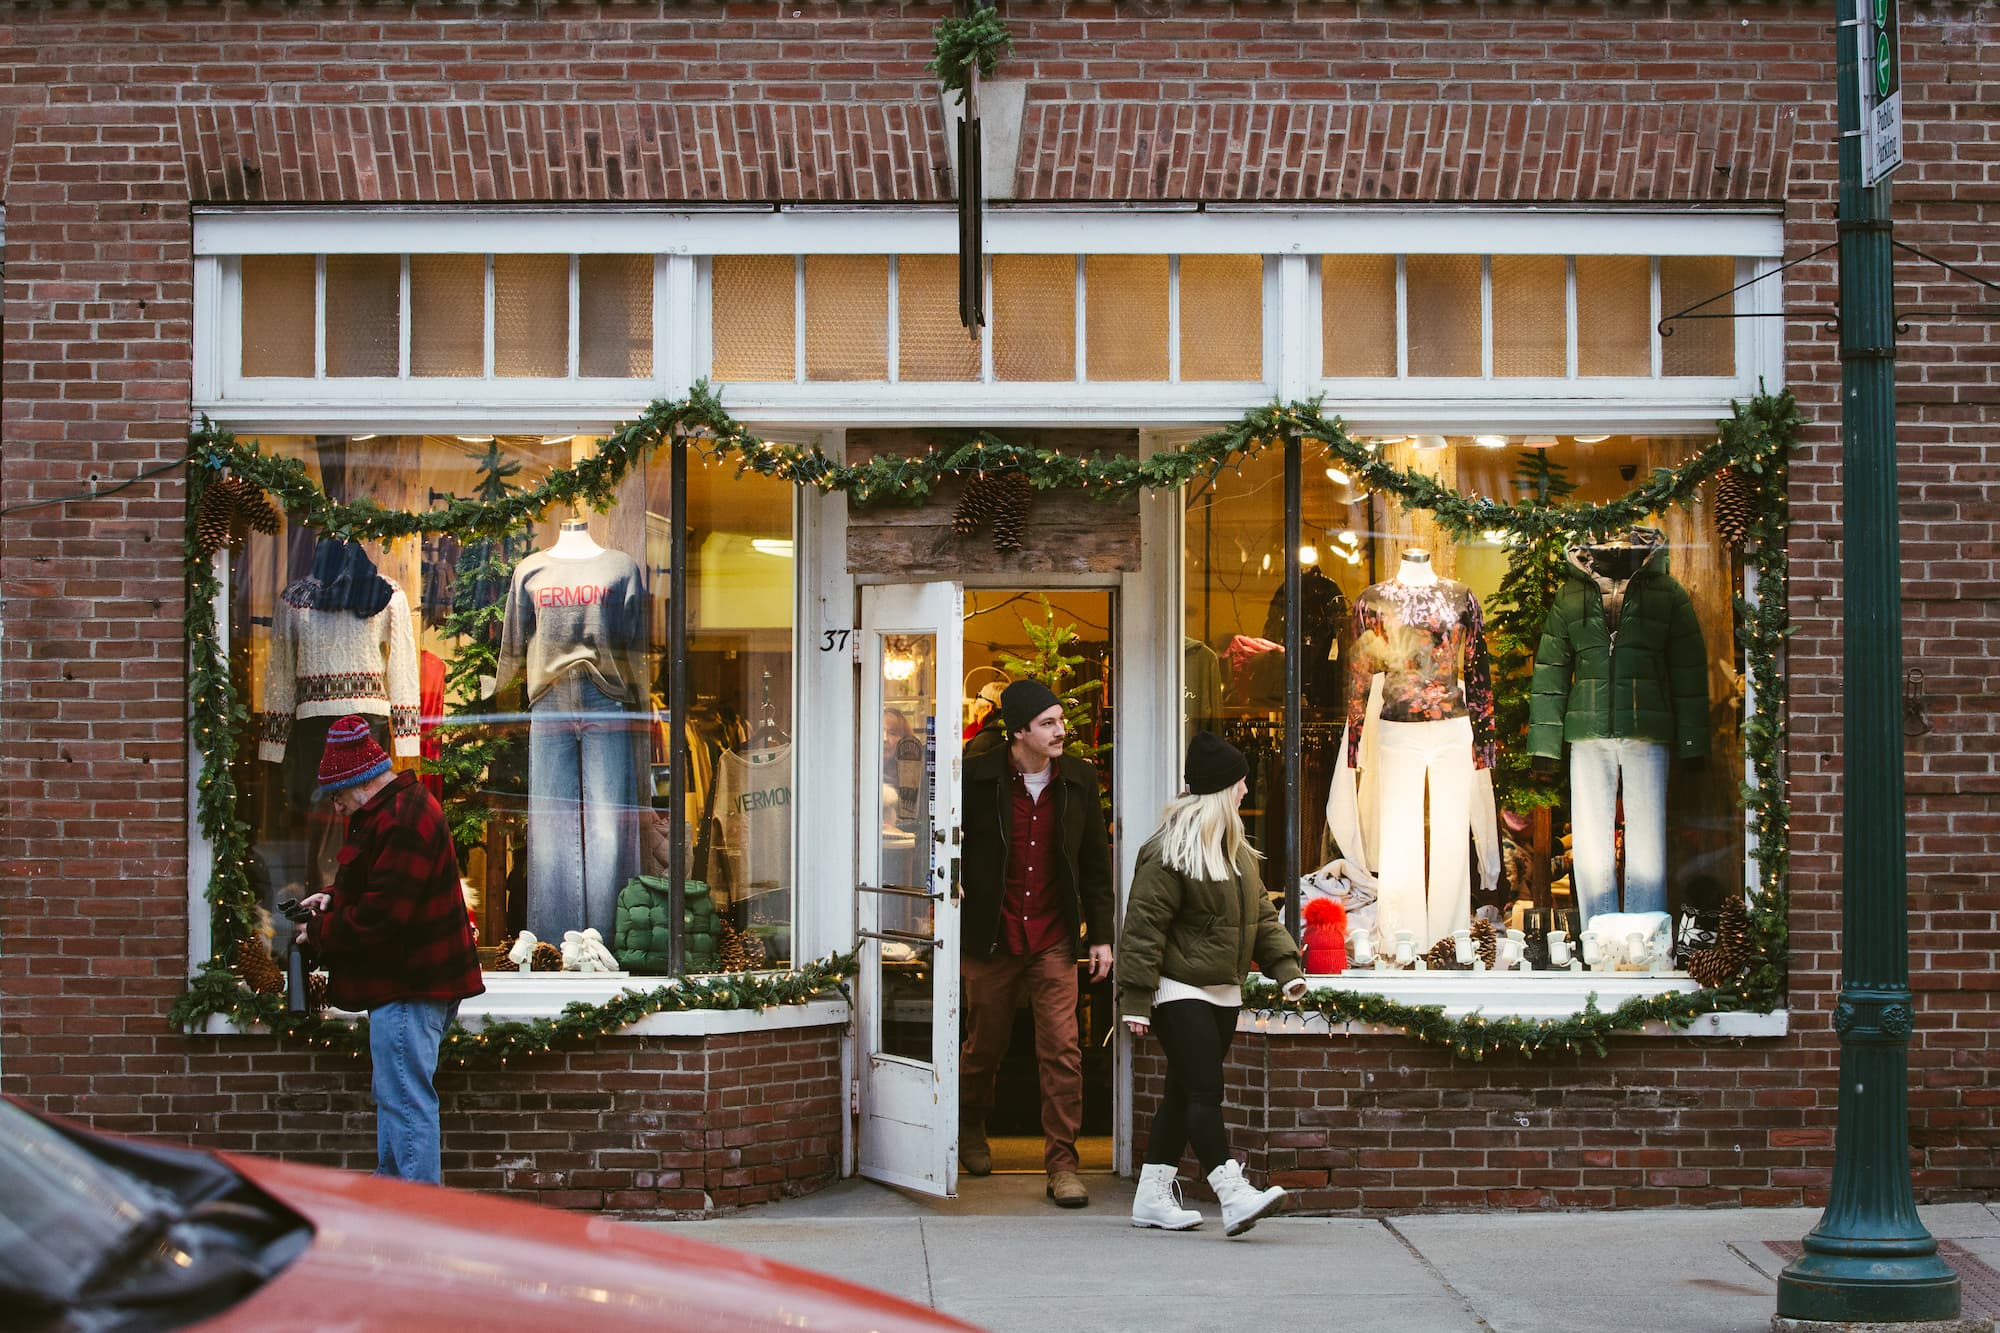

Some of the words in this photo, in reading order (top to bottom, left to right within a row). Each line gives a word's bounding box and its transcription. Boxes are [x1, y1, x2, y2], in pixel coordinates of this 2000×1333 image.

[1877, 101, 1894, 134] Public
[1876, 134, 1897, 167] Parking
[819, 629, 851, 652] 37
